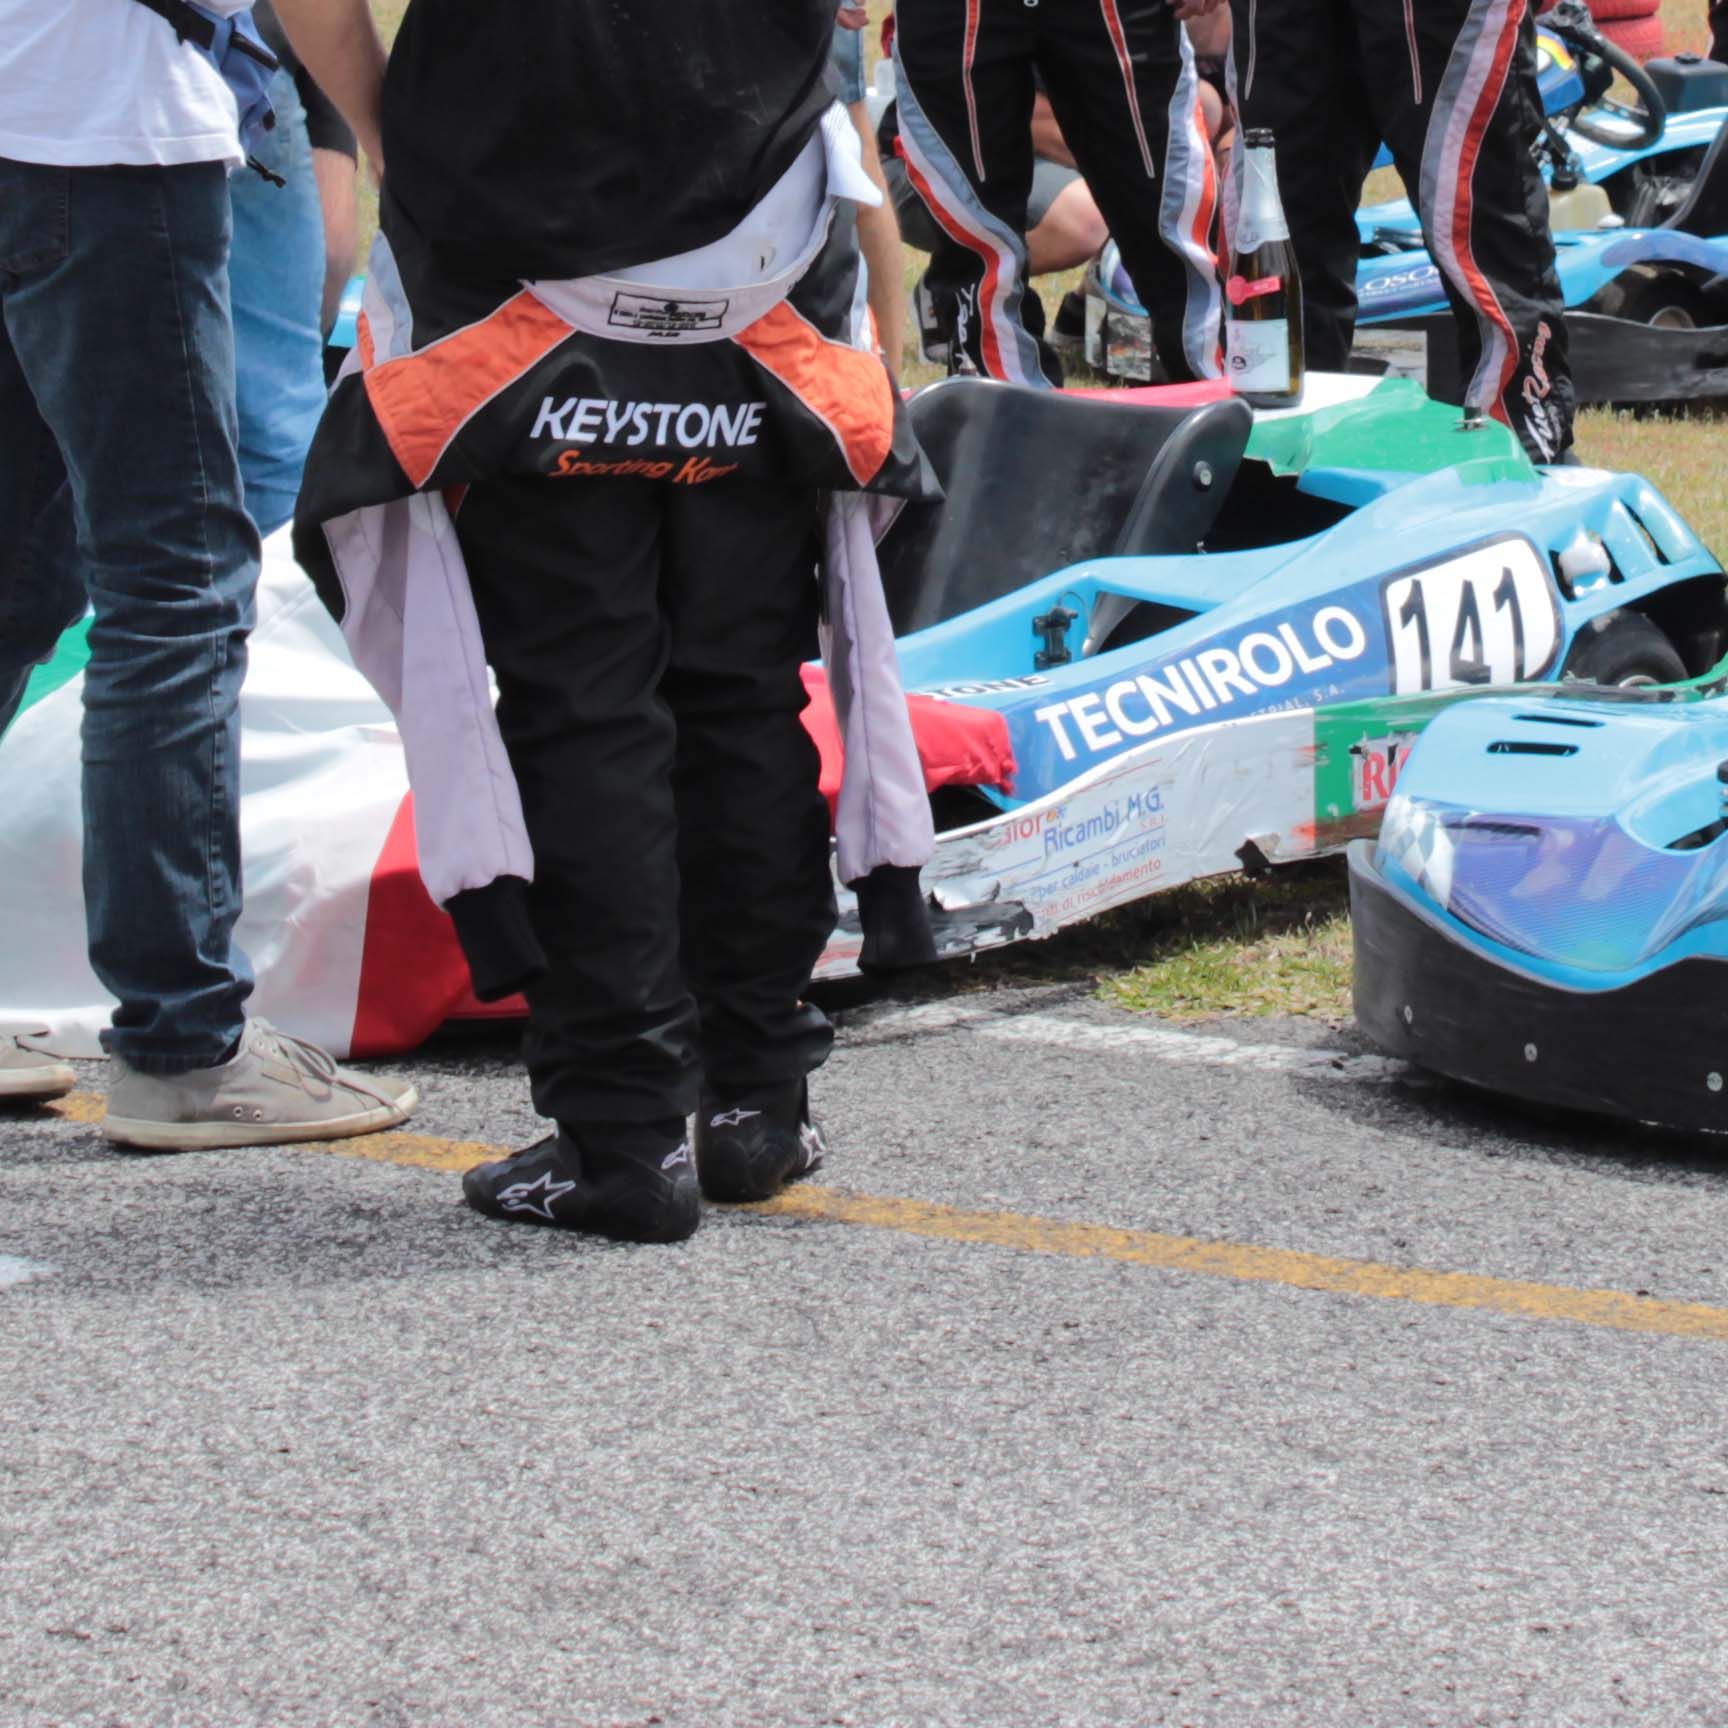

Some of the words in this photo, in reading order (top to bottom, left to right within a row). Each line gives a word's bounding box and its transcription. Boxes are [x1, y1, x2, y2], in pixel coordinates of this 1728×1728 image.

[529, 395, 767, 449] KEYSTONE
[1399, 566, 1526, 691] 141
[930, 675, 1051, 698] TONE
[1034, 605, 1366, 761] TECNIROLO
[1043, 806, 1120, 859] Ricambi
